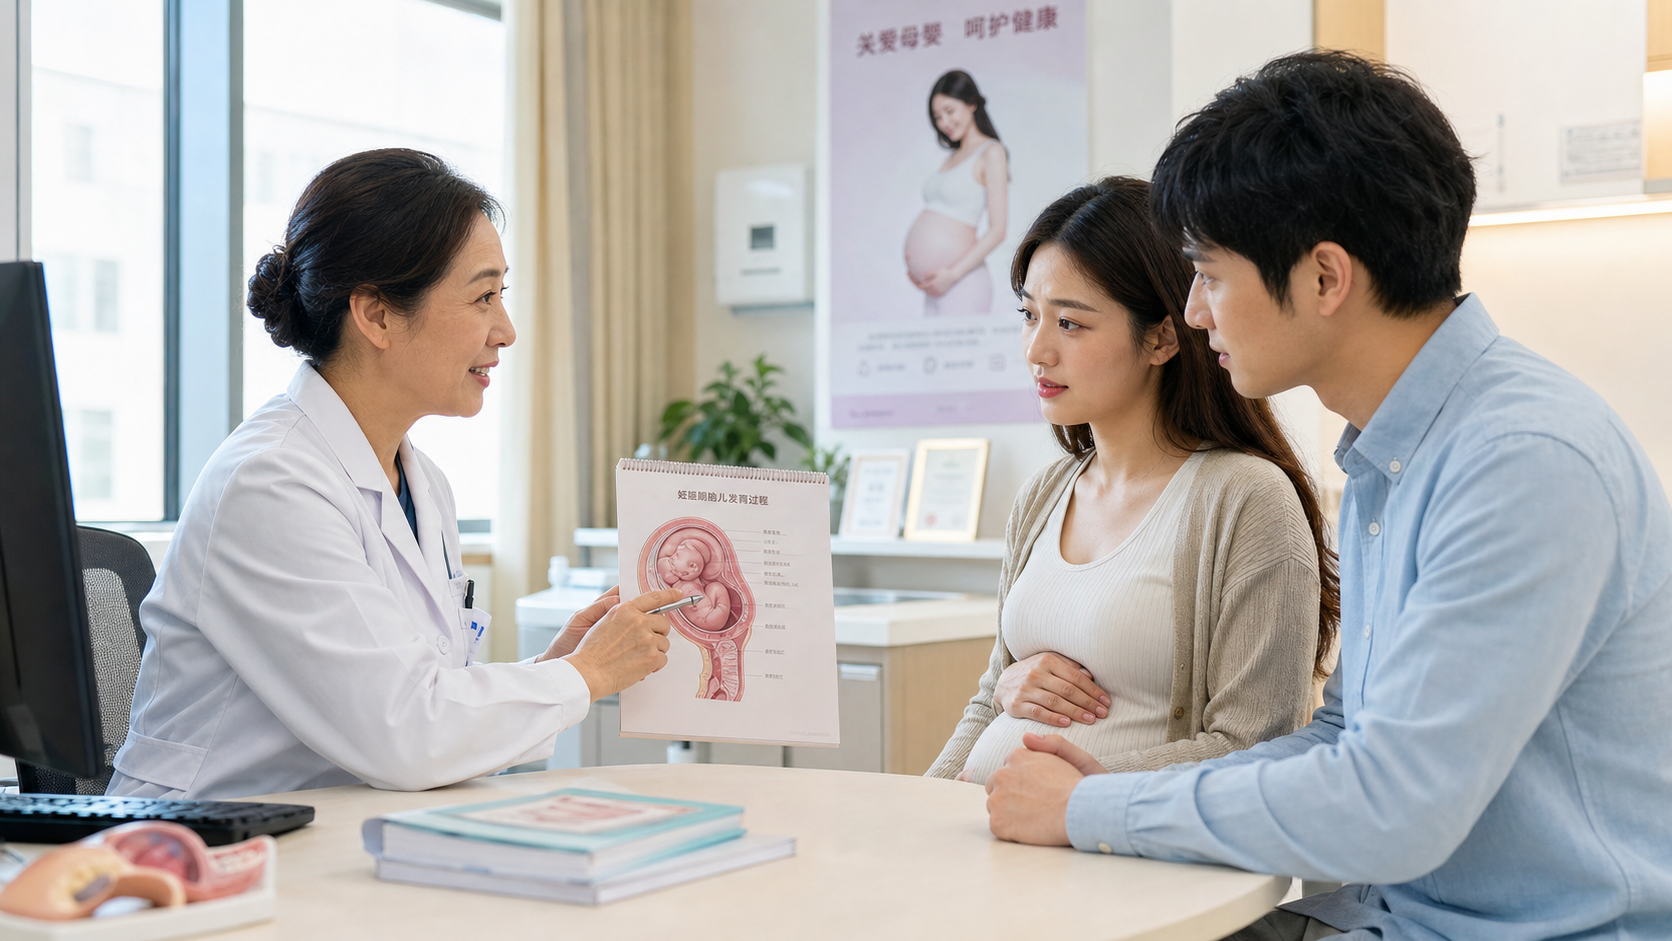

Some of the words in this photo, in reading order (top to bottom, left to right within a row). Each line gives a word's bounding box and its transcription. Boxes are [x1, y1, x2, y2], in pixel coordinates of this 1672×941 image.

[856, 22, 943, 57] 关爱母婴
[964, 5, 1059, 40] 呵护健康
